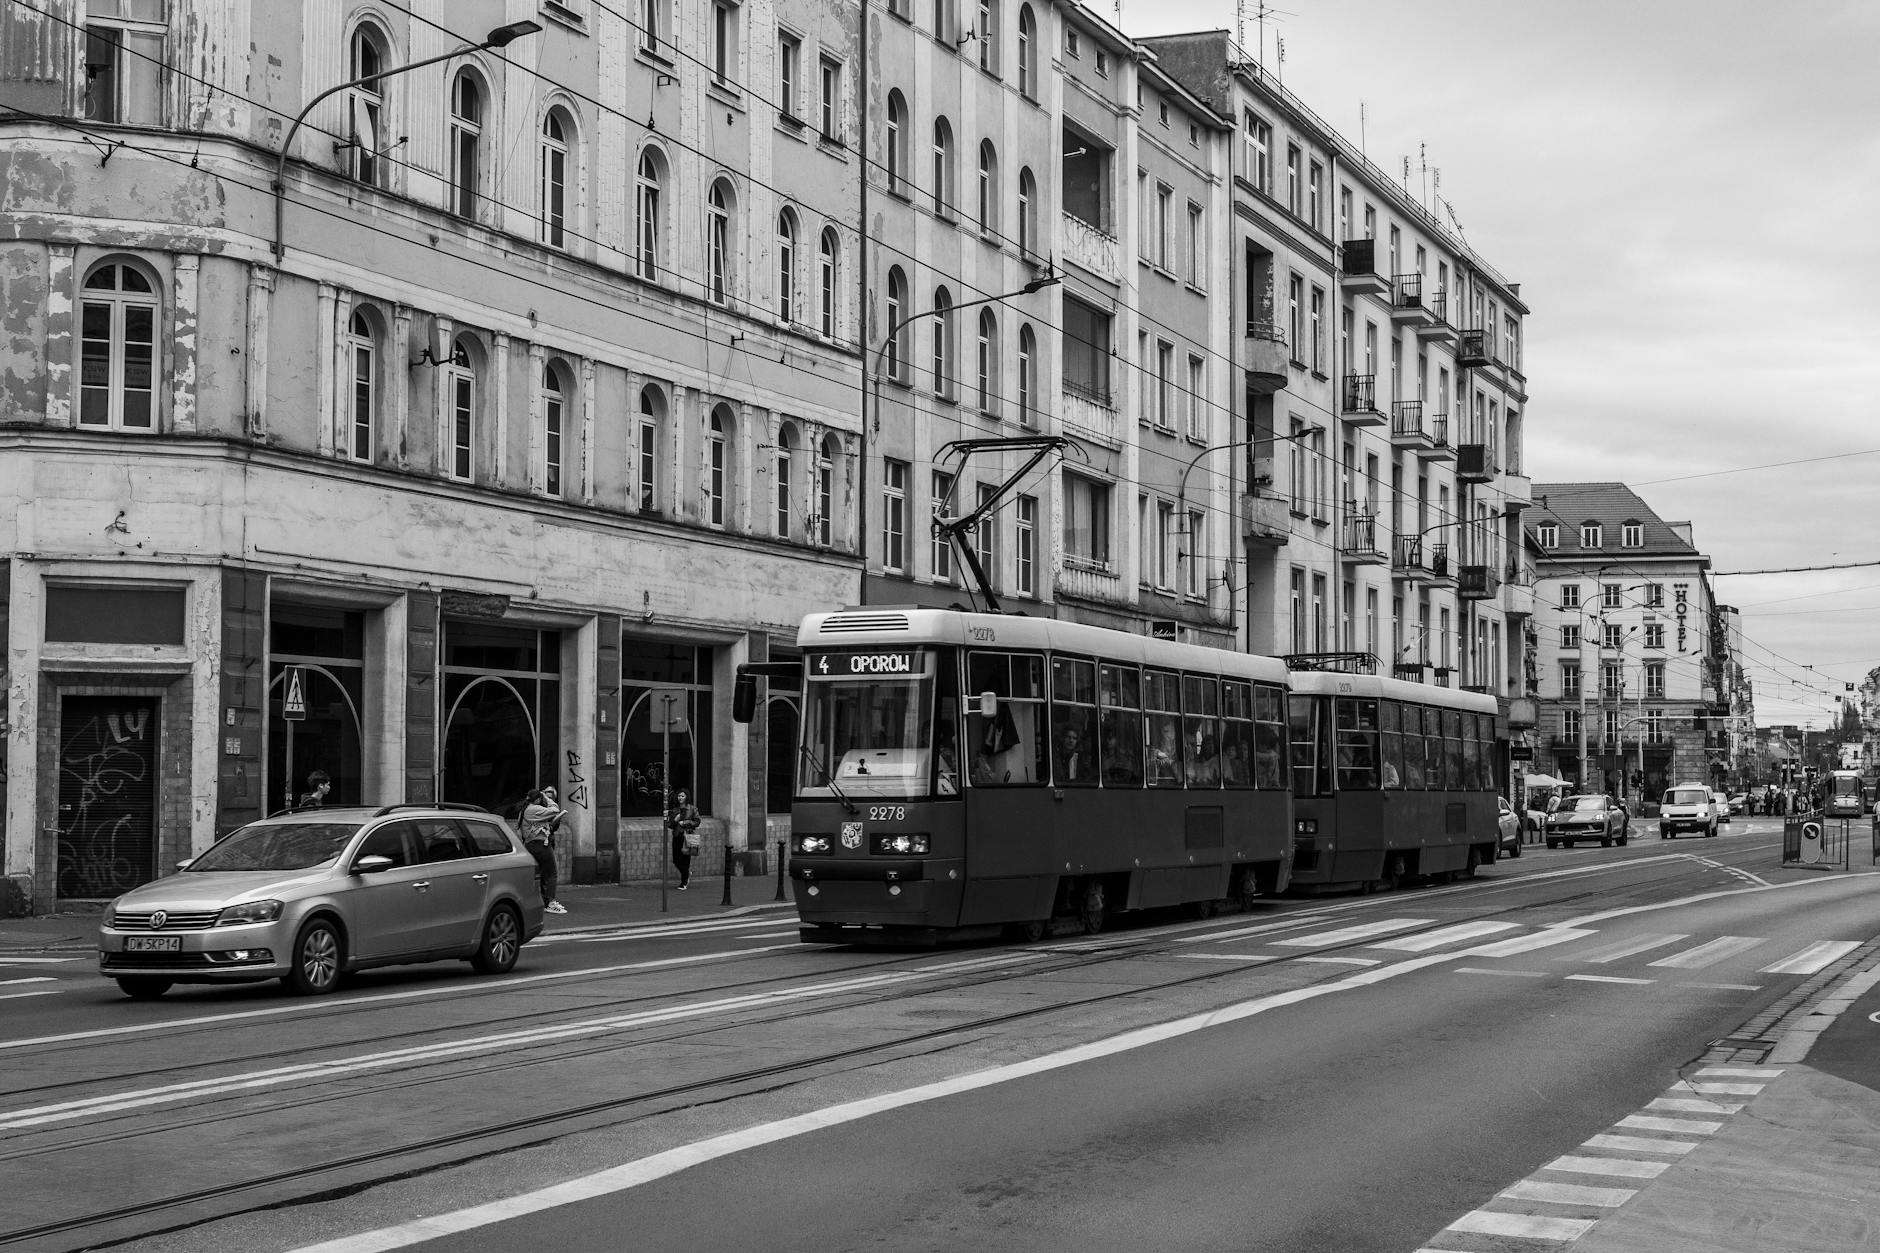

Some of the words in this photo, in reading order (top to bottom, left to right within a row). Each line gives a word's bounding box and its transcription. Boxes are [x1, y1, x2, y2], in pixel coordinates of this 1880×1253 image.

[1675, 590, 1687, 652] HOTEL
[819, 656, 829, 674] 4
[869, 806, 905, 821] 2278
